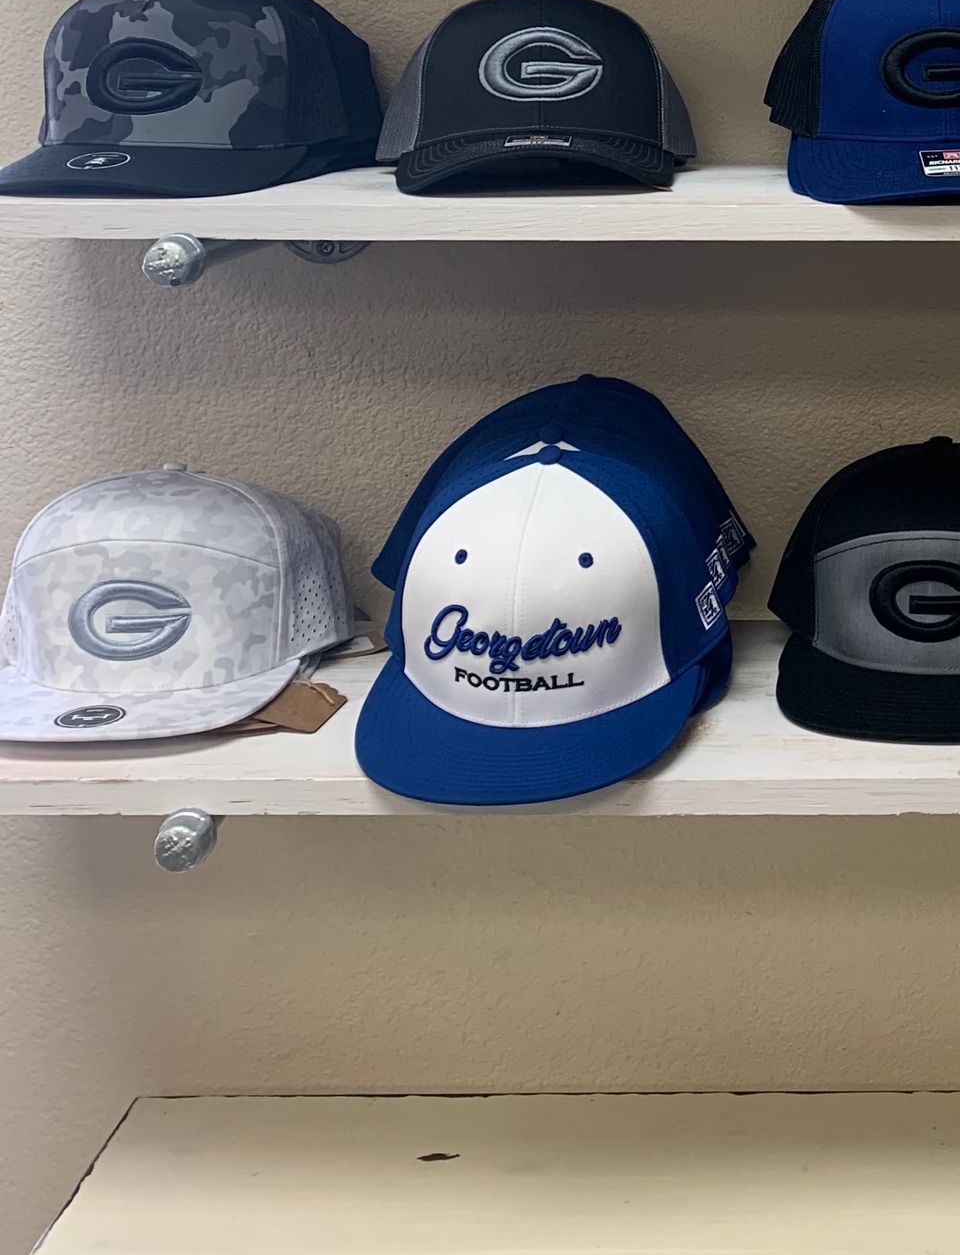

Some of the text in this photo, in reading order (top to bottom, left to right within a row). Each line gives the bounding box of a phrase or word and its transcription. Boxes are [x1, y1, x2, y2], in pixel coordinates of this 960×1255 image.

[86, 38, 203, 116] G
[479, 26, 602, 103] G
[68, 578, 192, 662] G
[424, 604, 622, 674] Georgetown
[454, 667, 585, 693] FOOTBALL
